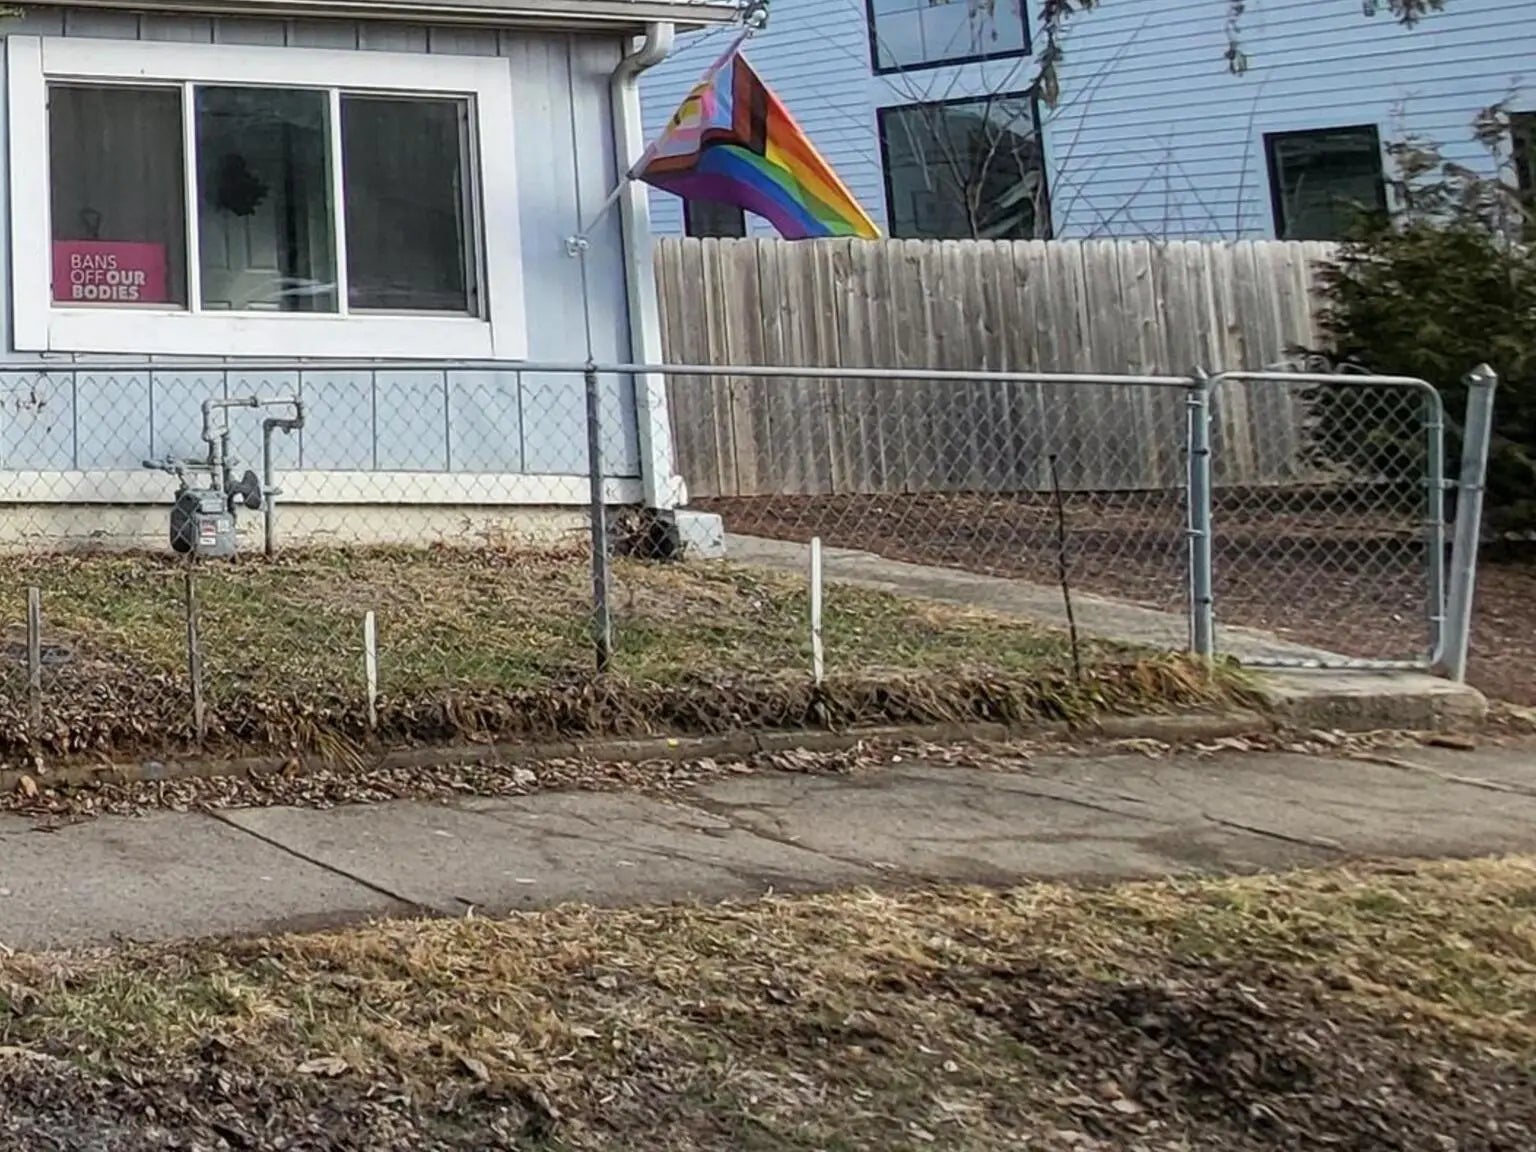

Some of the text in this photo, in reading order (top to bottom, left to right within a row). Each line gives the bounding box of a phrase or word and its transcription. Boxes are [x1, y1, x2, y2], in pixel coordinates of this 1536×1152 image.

[71, 254, 117, 269] BANS
[70, 269, 146, 285] OFF OUR
[72, 285, 139, 299] BODIES
